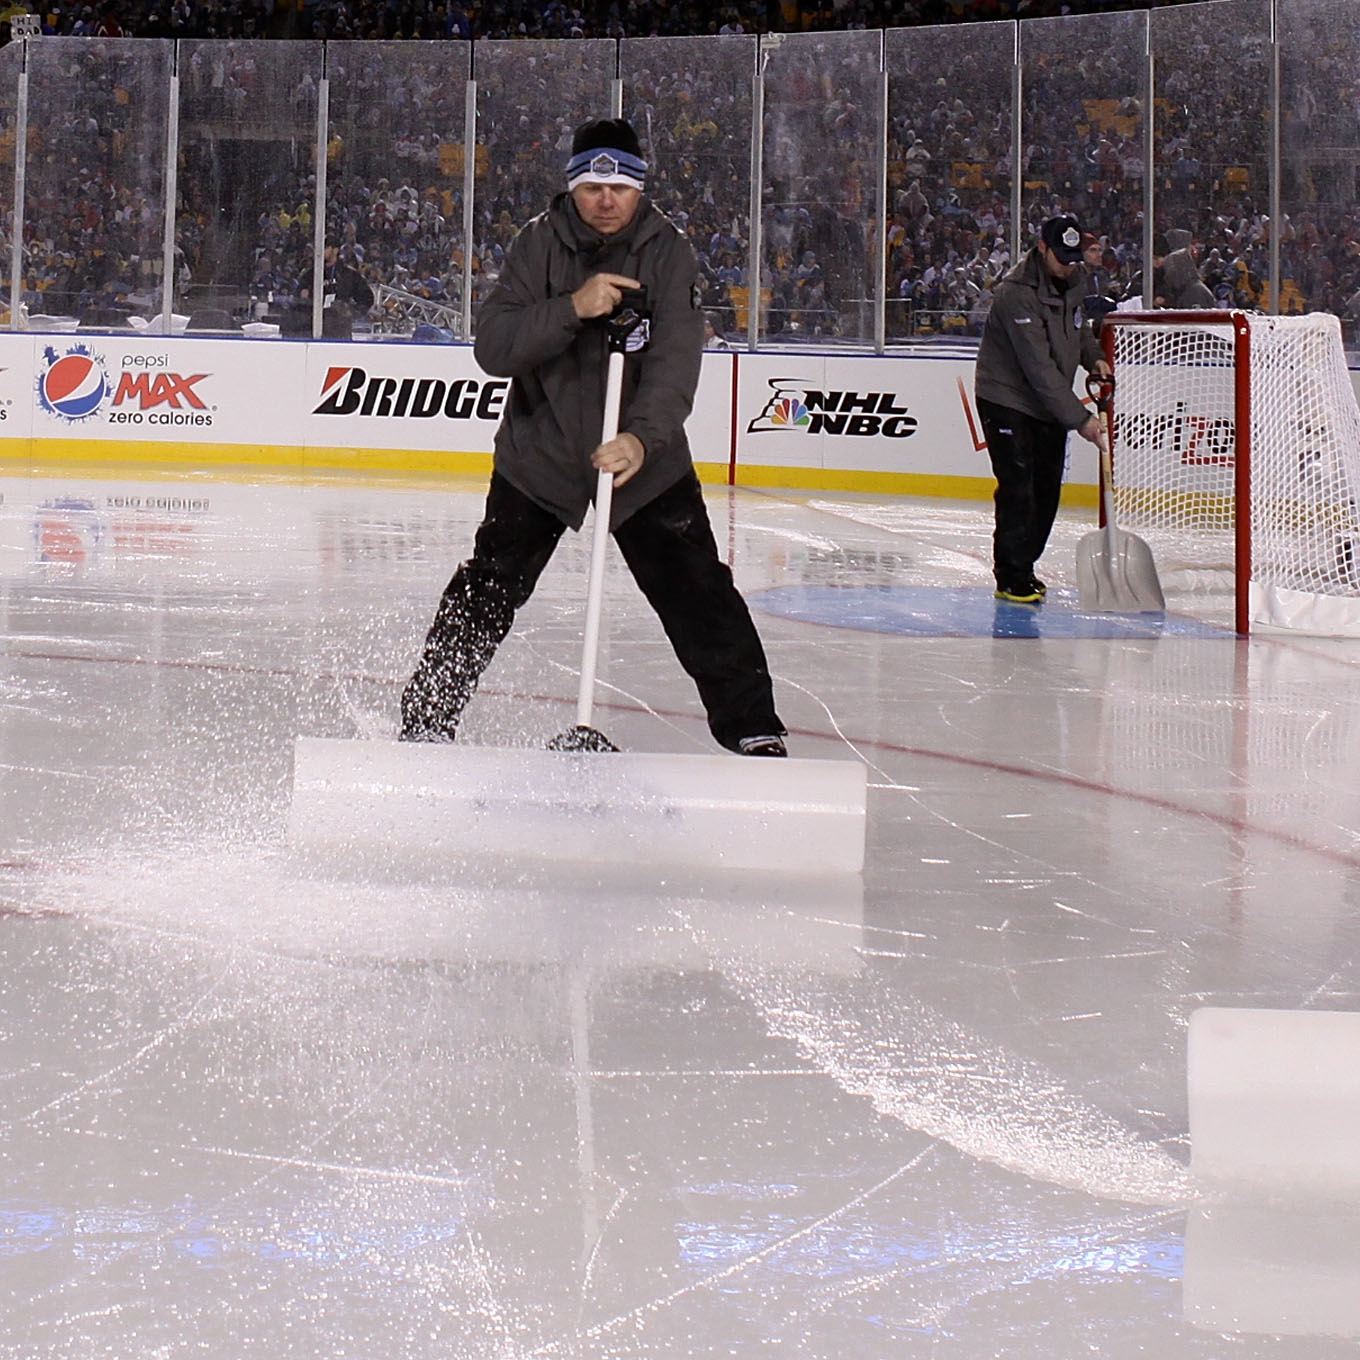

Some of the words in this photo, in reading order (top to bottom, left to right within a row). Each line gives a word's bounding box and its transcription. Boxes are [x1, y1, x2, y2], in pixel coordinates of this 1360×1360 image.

[16, 17, 33, 26] HI
[17, 26, 41, 36] DAD
[121, 353, 169, 369] pepsi
[111, 372, 214, 410] MAX
[312, 367, 509, 420] BRIDGE
[801, 390, 909, 415] NHL
[108, 411, 144, 424] zero
[149, 411, 213, 426] calories
[806, 413, 918, 439] NBC
